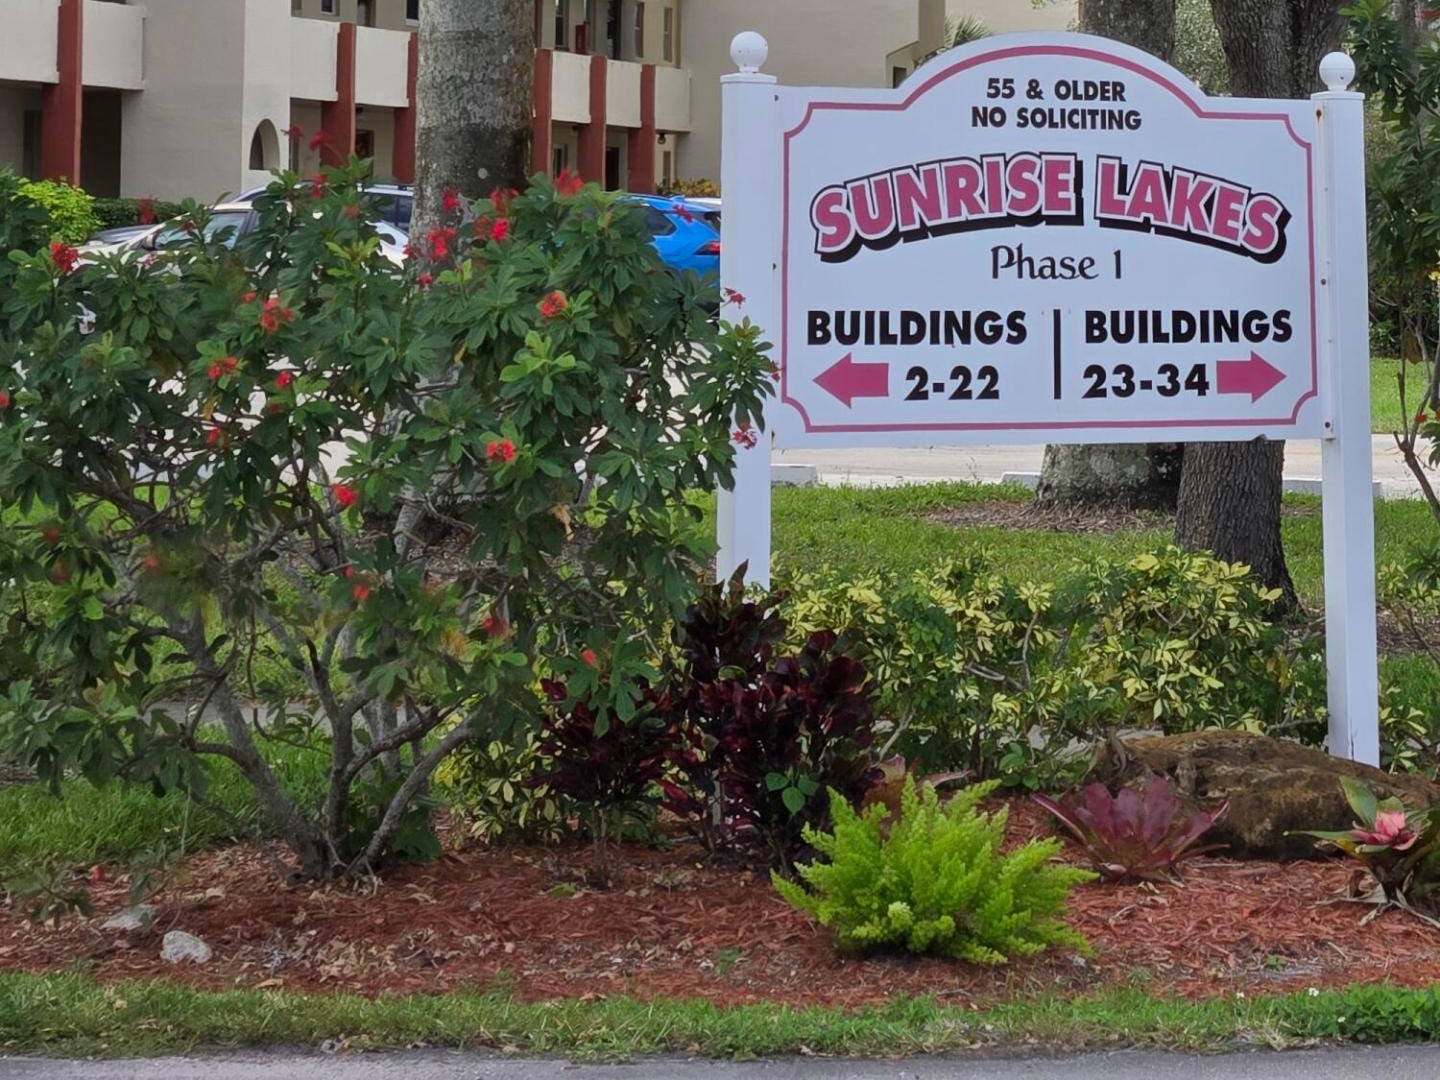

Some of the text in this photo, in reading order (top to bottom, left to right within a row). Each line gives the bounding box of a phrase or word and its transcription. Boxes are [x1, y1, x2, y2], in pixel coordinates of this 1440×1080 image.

[986, 77, 1127, 103] 55 & OLDER
[971, 105, 1142, 131] NO SOLICITING
[810, 151, 1292, 264] SUNRISE LAKES
[989, 244, 1100, 281] Phase
[807, 309, 1028, 347] BUILDINGS
[1084, 308, 1294, 345] BUILDINGS
[904, 365, 1001, 401] 2-22
[1082, 363, 1210, 399] 23-34
